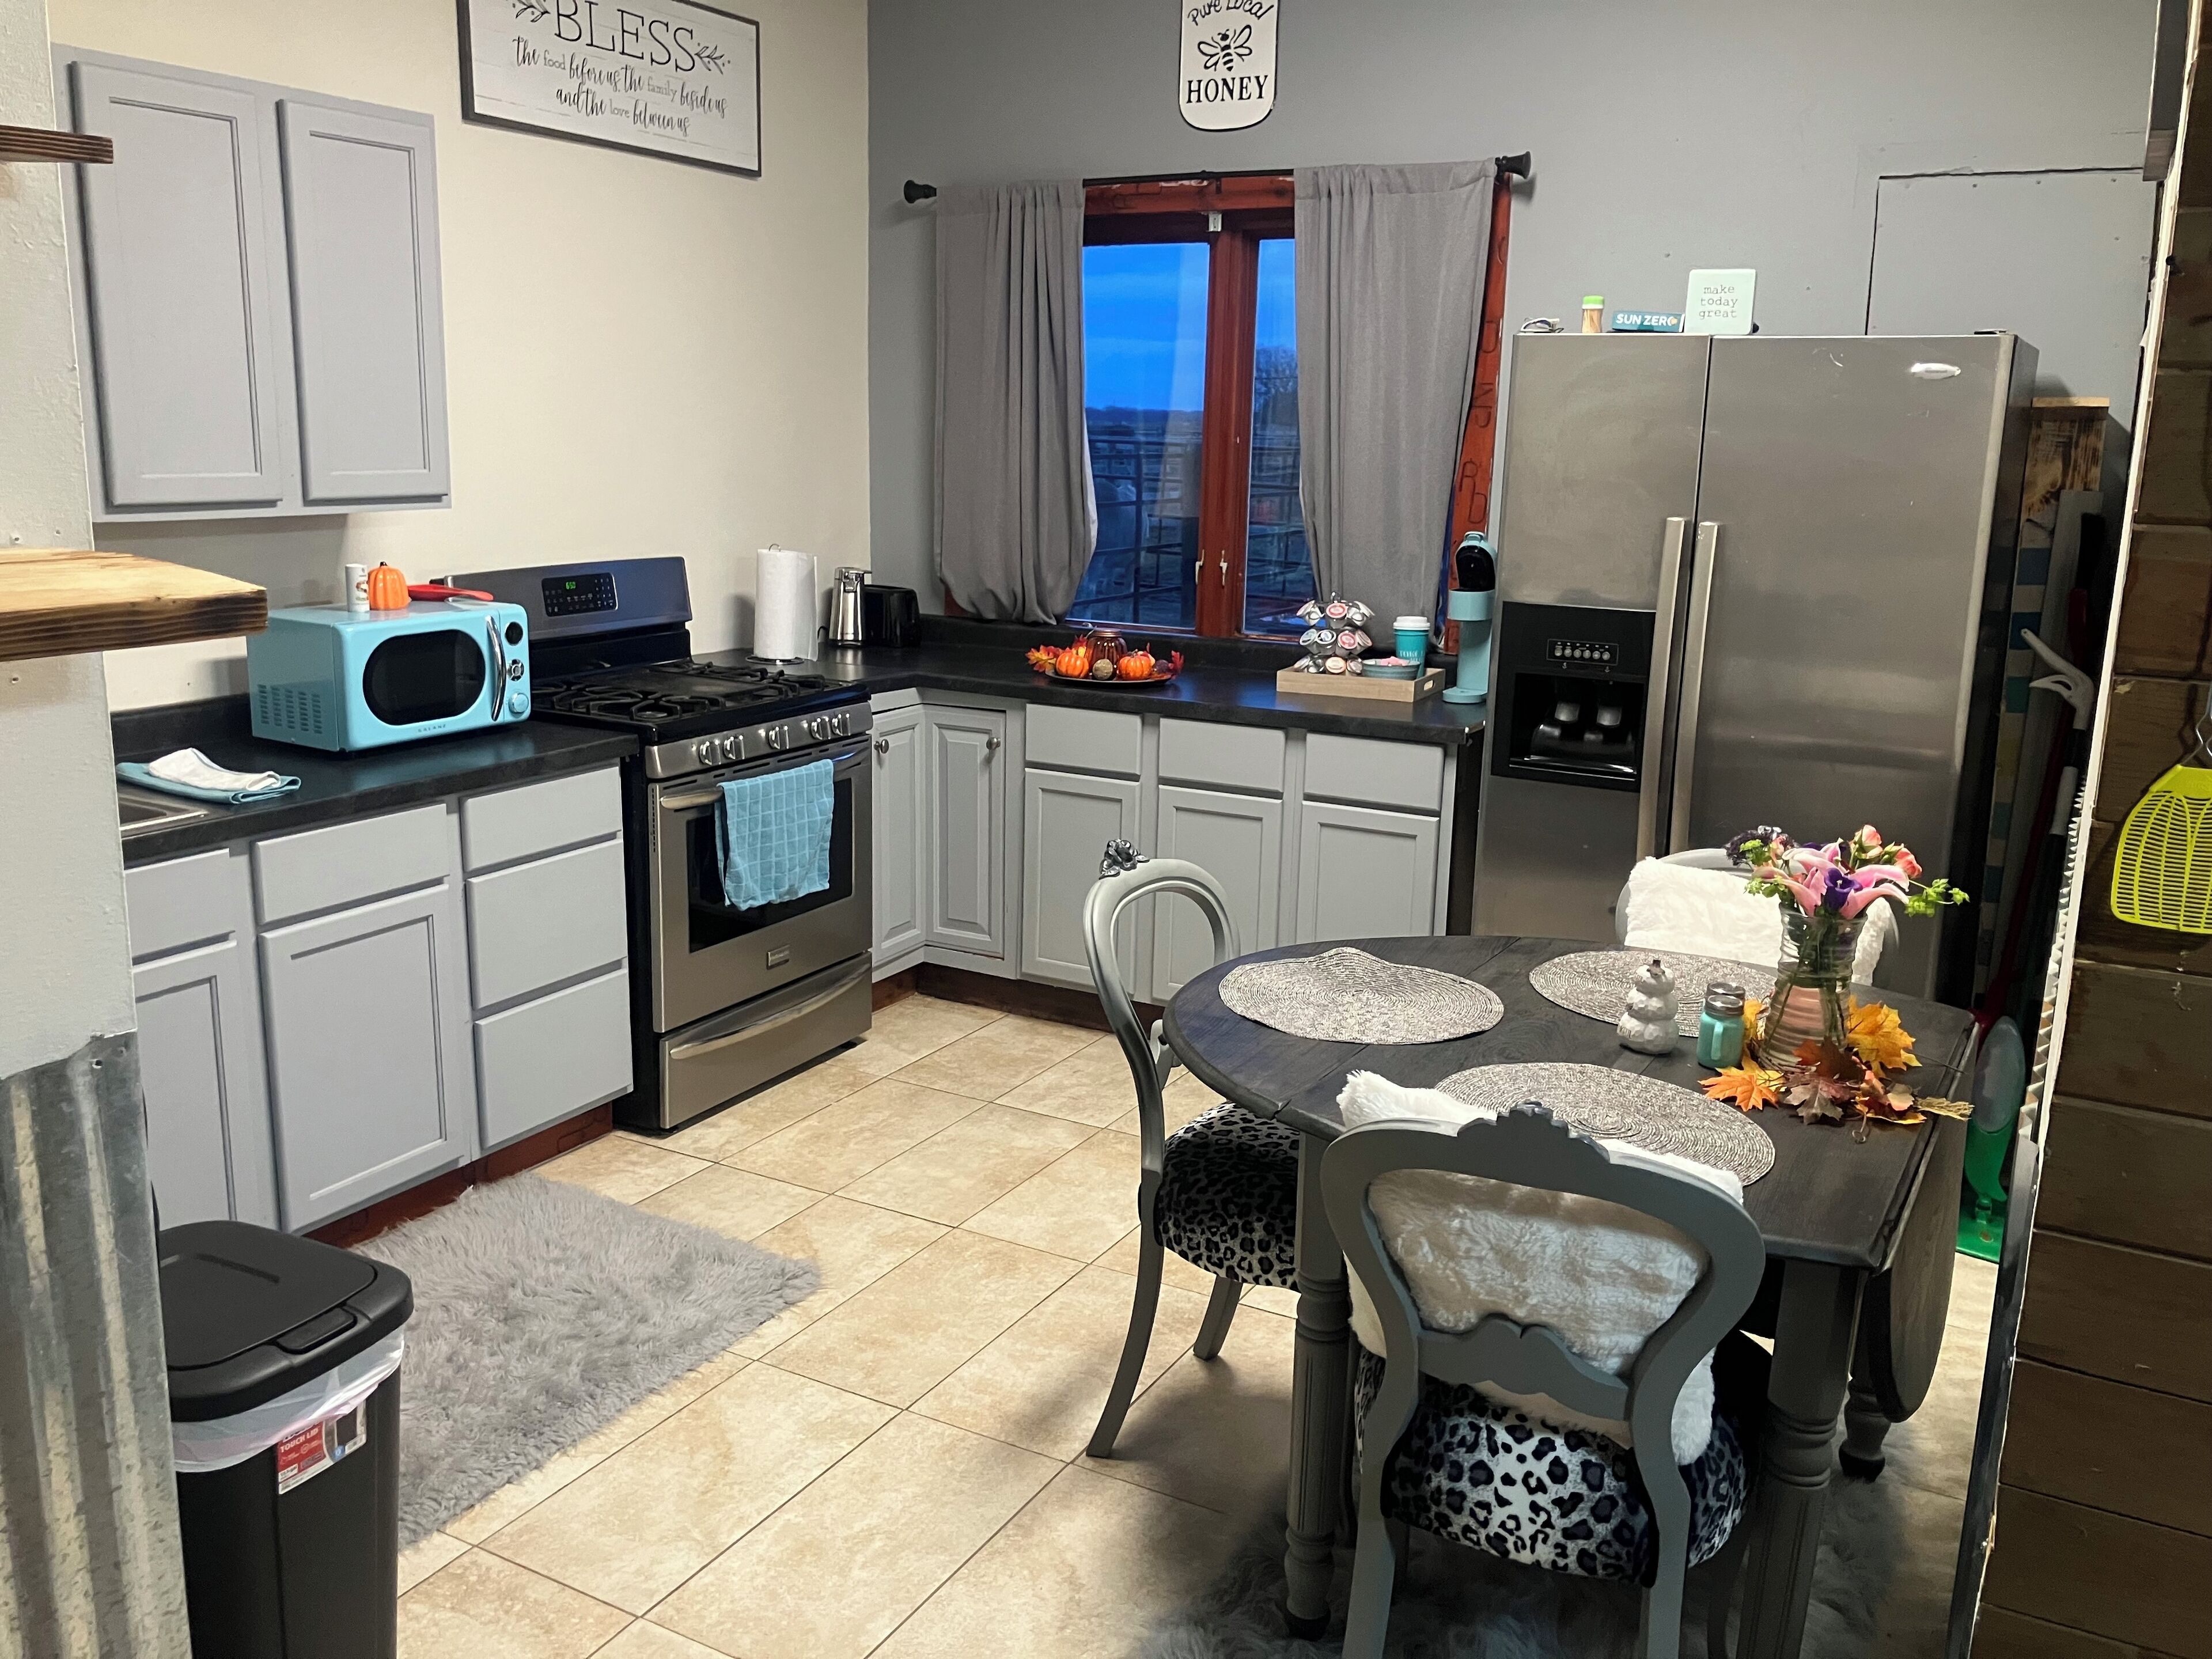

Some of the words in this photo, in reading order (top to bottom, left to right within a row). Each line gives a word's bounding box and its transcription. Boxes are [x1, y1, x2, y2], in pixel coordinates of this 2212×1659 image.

[1187, 0, 1222, 26] Pure
[555, 0, 695, 71] BLESS
[512, 36, 540, 66] the
[544, 50, 566, 70] food
[569, 52, 605, 85] before
[621, 64, 644, 92] the
[647, 76, 677, 102] family
[680, 82, 714, 114] beside
[1186, 75, 1268, 104] HONEY
[556, 82, 584, 113] and
[581, 88, 607, 116] the
[609, 99, 630, 118] love
[633, 99, 677, 129] between
[1703, 285, 1735, 294] make
[1700, 296, 1738, 308] today
[1615, 313, 1642, 325] SUN
[1699, 309, 1737, 320] great
[280, 1434, 306, 1453] TOUCH
